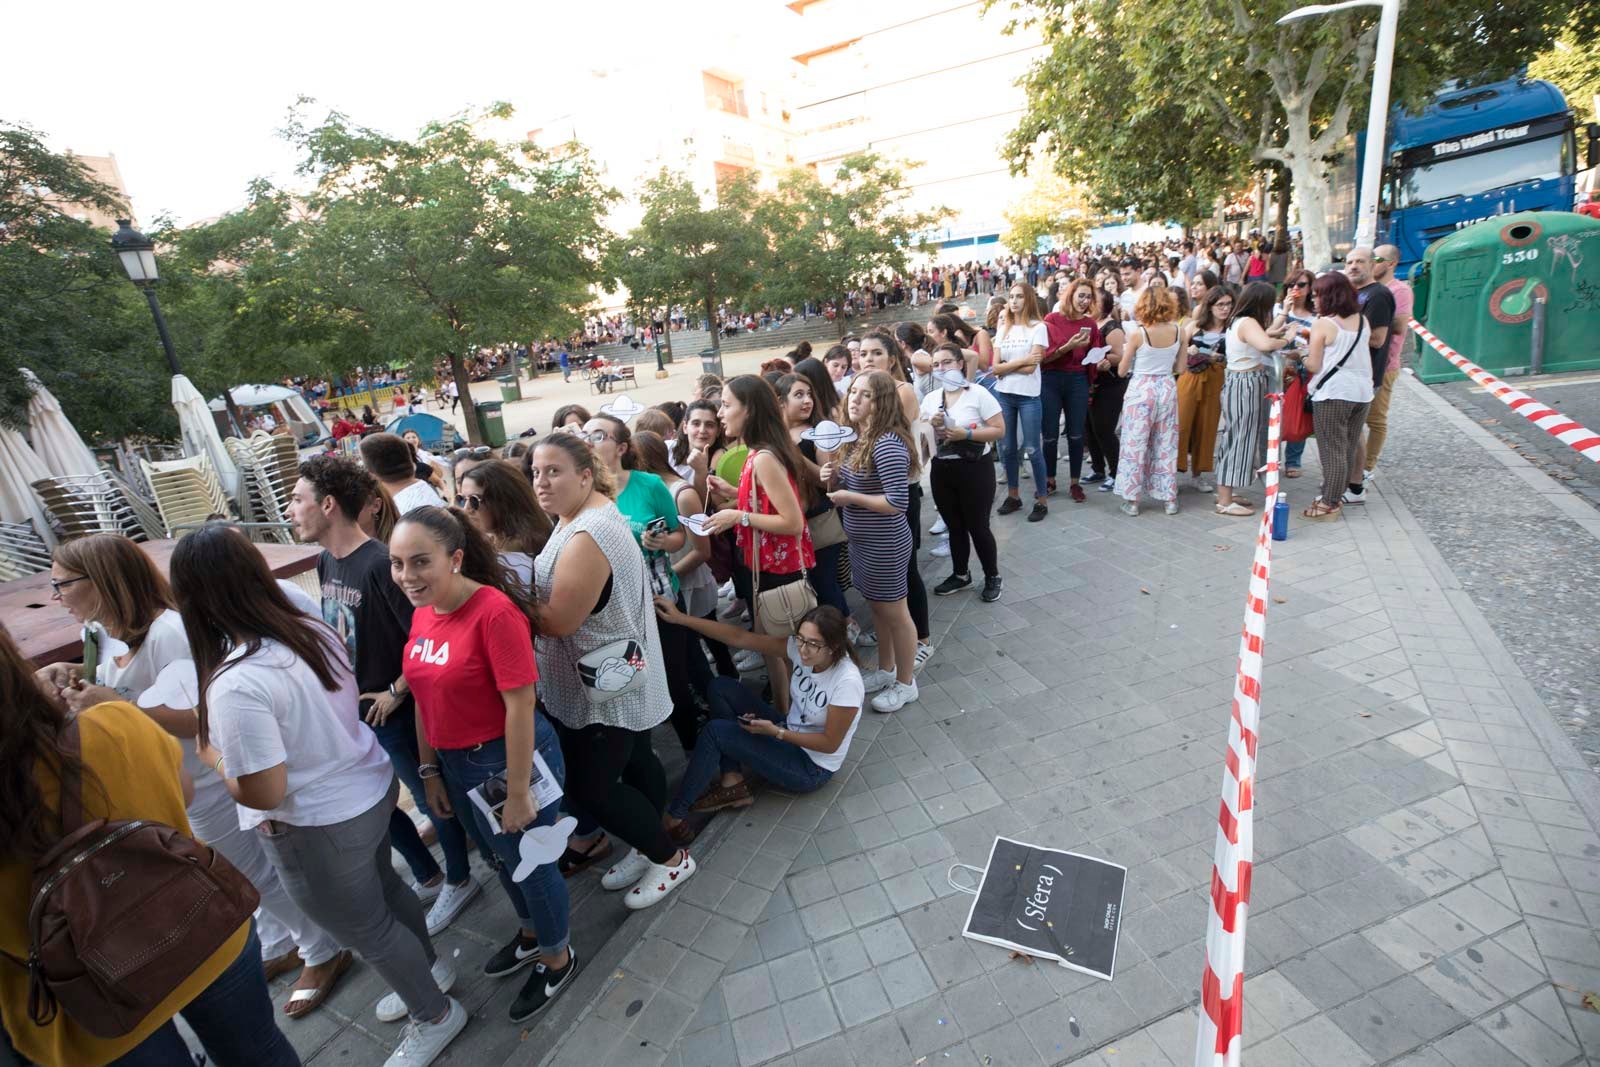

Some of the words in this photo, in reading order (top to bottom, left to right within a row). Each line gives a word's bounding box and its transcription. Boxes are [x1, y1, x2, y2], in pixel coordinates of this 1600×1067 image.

[1432, 142, 1461, 157] The
[1495, 124, 1530, 140] Tour
[409, 636, 449, 666] FILA
